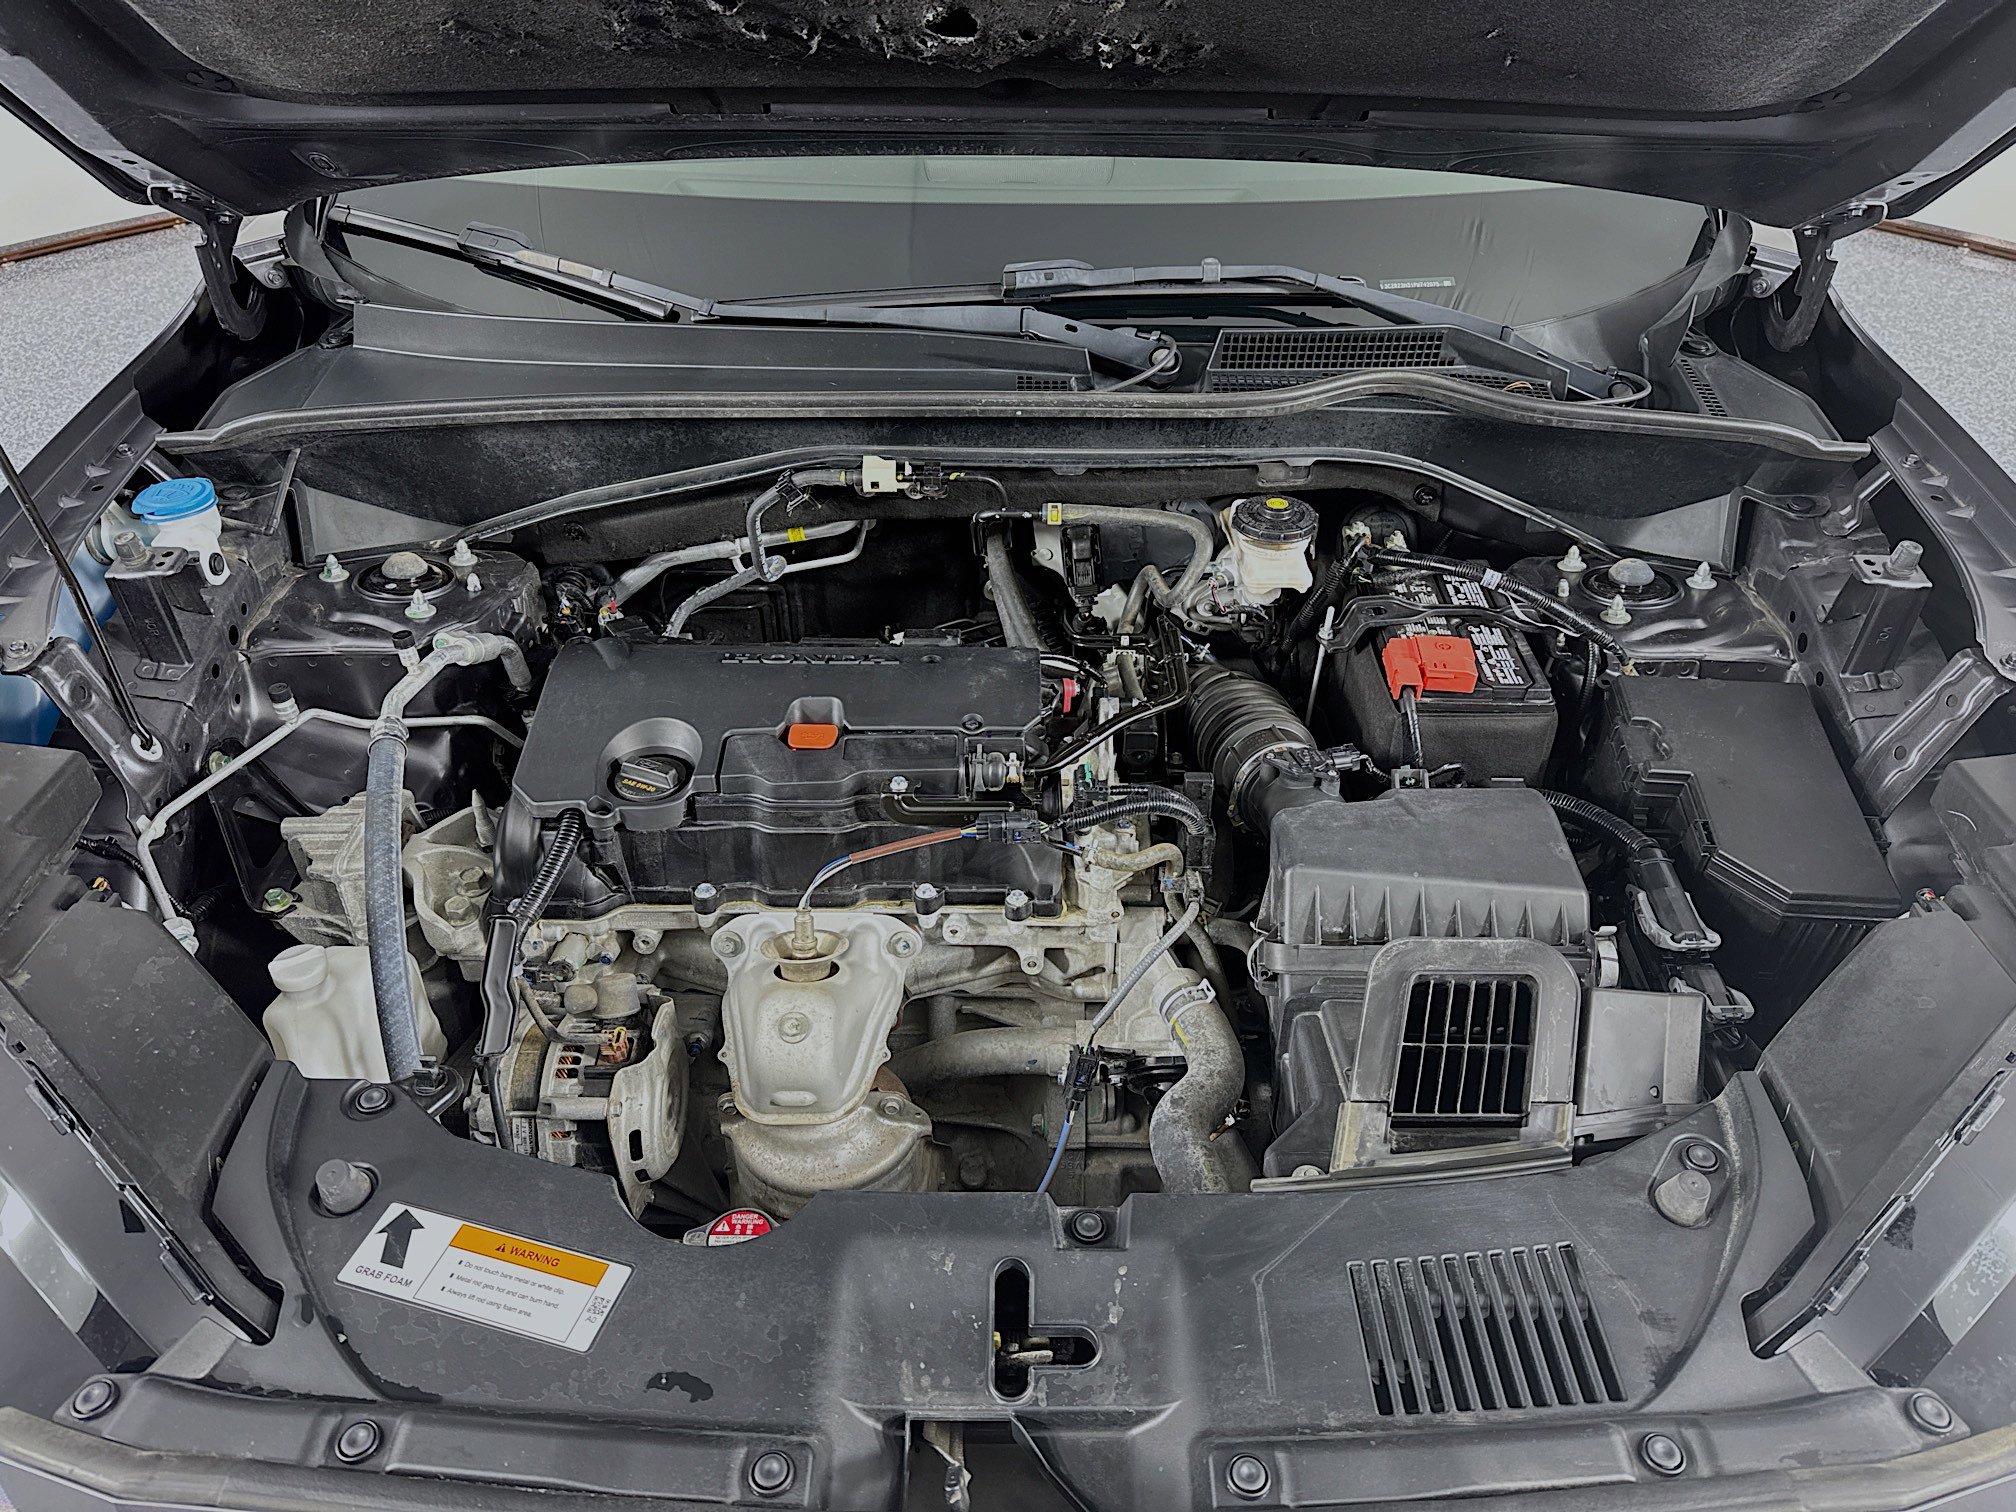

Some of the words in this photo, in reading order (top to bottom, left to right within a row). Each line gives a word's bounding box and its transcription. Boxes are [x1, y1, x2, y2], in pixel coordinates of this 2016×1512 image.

[721, 653, 900, 665] HONDA
[622, 778, 636, 787] SAE
[510, 1246, 560, 1267] WARNING
[355, 1265, 383, 1279] GRAB
[383, 1273, 413, 1288] FOAM
[464, 1261, 473, 1269] Do
[484, 1267, 500, 1276] touch
[500, 1272, 513, 1280] bare
[513, 1275, 530, 1285] metal
[538, 1282, 553, 1292] white
[447, 1288, 467, 1299] Always
[467, 1293, 476, 1301] lift
[486, 1300, 502, 1310] using
[502, 1303, 518, 1313] foam
[456, 1274, 472, 1284] Metal
[482, 1282, 495, 1291] gets
[495, 1285, 506, 1294] hot
[506, 1289, 518, 1297] and
[529, 1295, 543, 1304] burn
